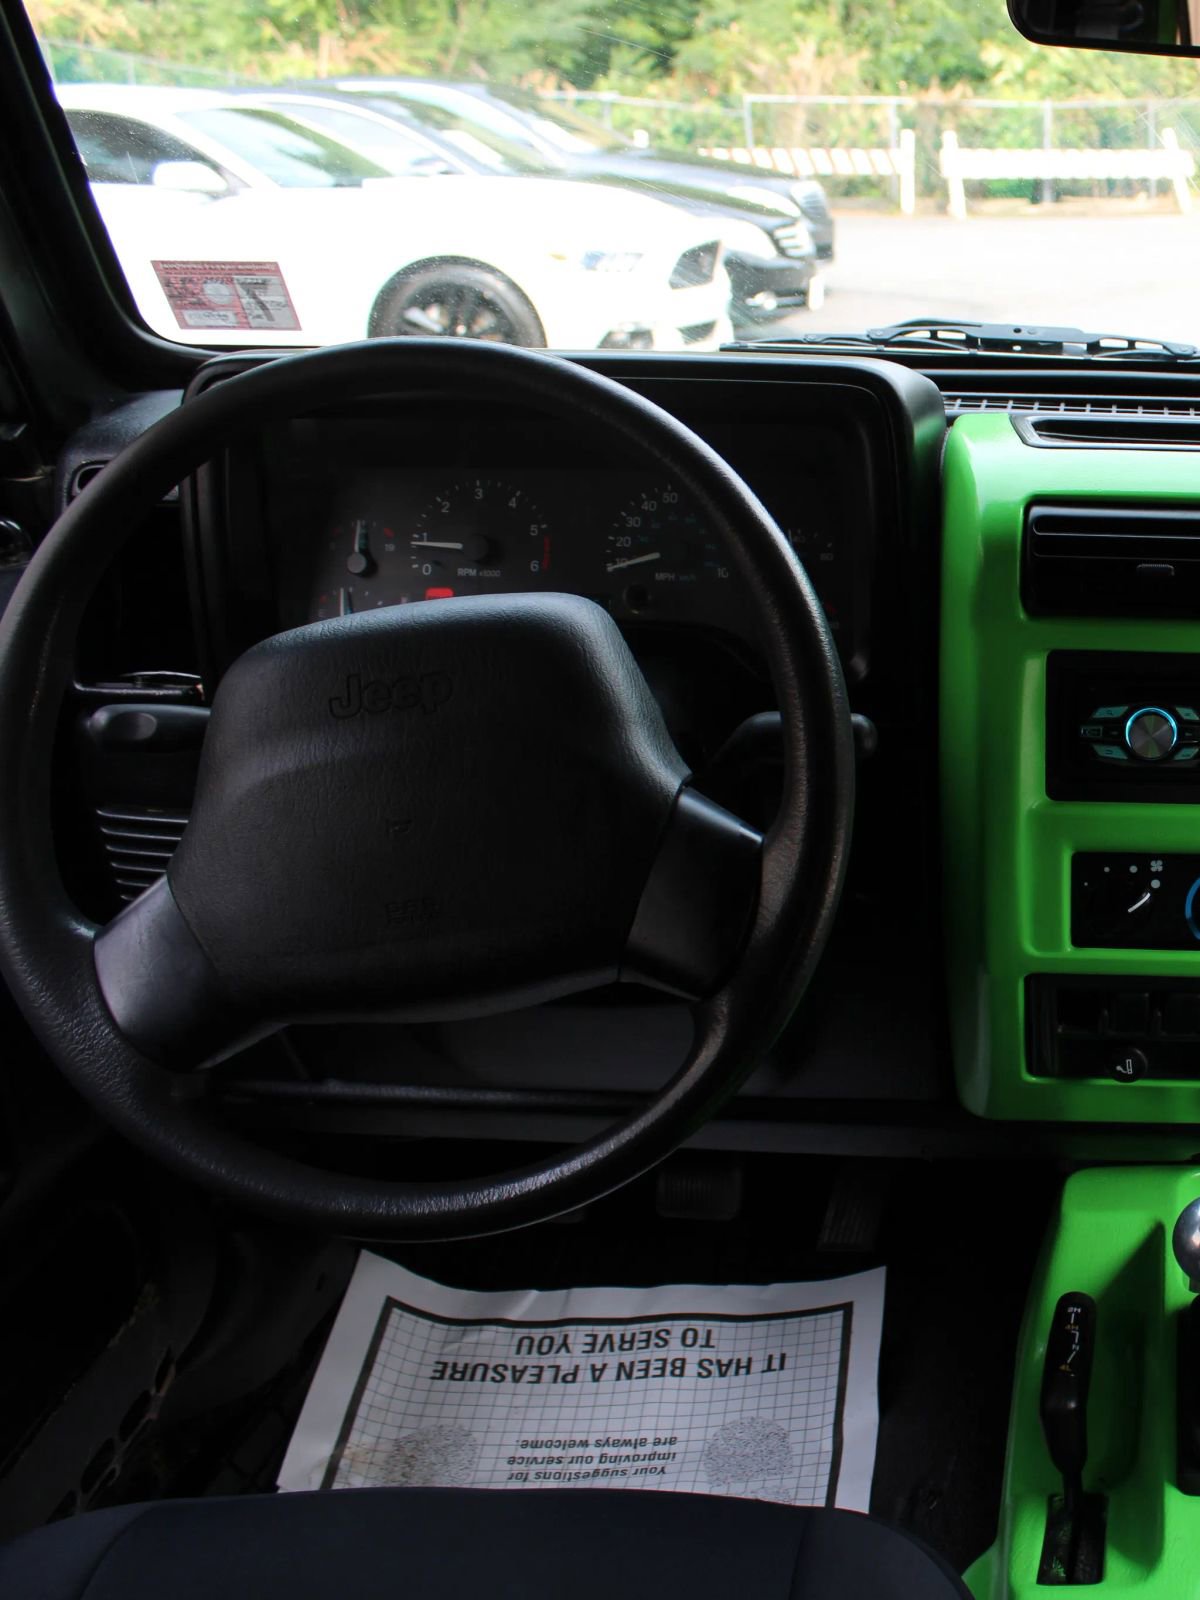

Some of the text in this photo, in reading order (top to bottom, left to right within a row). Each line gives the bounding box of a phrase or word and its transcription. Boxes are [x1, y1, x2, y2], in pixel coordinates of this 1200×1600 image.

[475, 488, 483, 499] 3
[663, 492, 678, 504] 50
[441, 501, 450, 513] 2
[508, 497, 517, 509] 4
[641, 500, 657, 512] 40
[625, 516, 641, 528] 30
[529, 524, 538, 536] 5
[615, 537, 631, 548] 20
[422, 563, 432, 576] 0
[530, 560, 539, 571] 6
[457, 567, 477, 578] RPM
[655, 572, 676, 582] MPH
[328, 670, 454, 719] Jeep
[515, 1327, 716, 1356] TO SERVE YOU
[430, 1353, 786, 1384] IT HAS BEEN A PLEASURE
[516, 1436, 677, 1449] are always welcome.
[507, 1452, 676, 1465] improving our service
[508, 1466, 666, 1482] Your suggestions for
